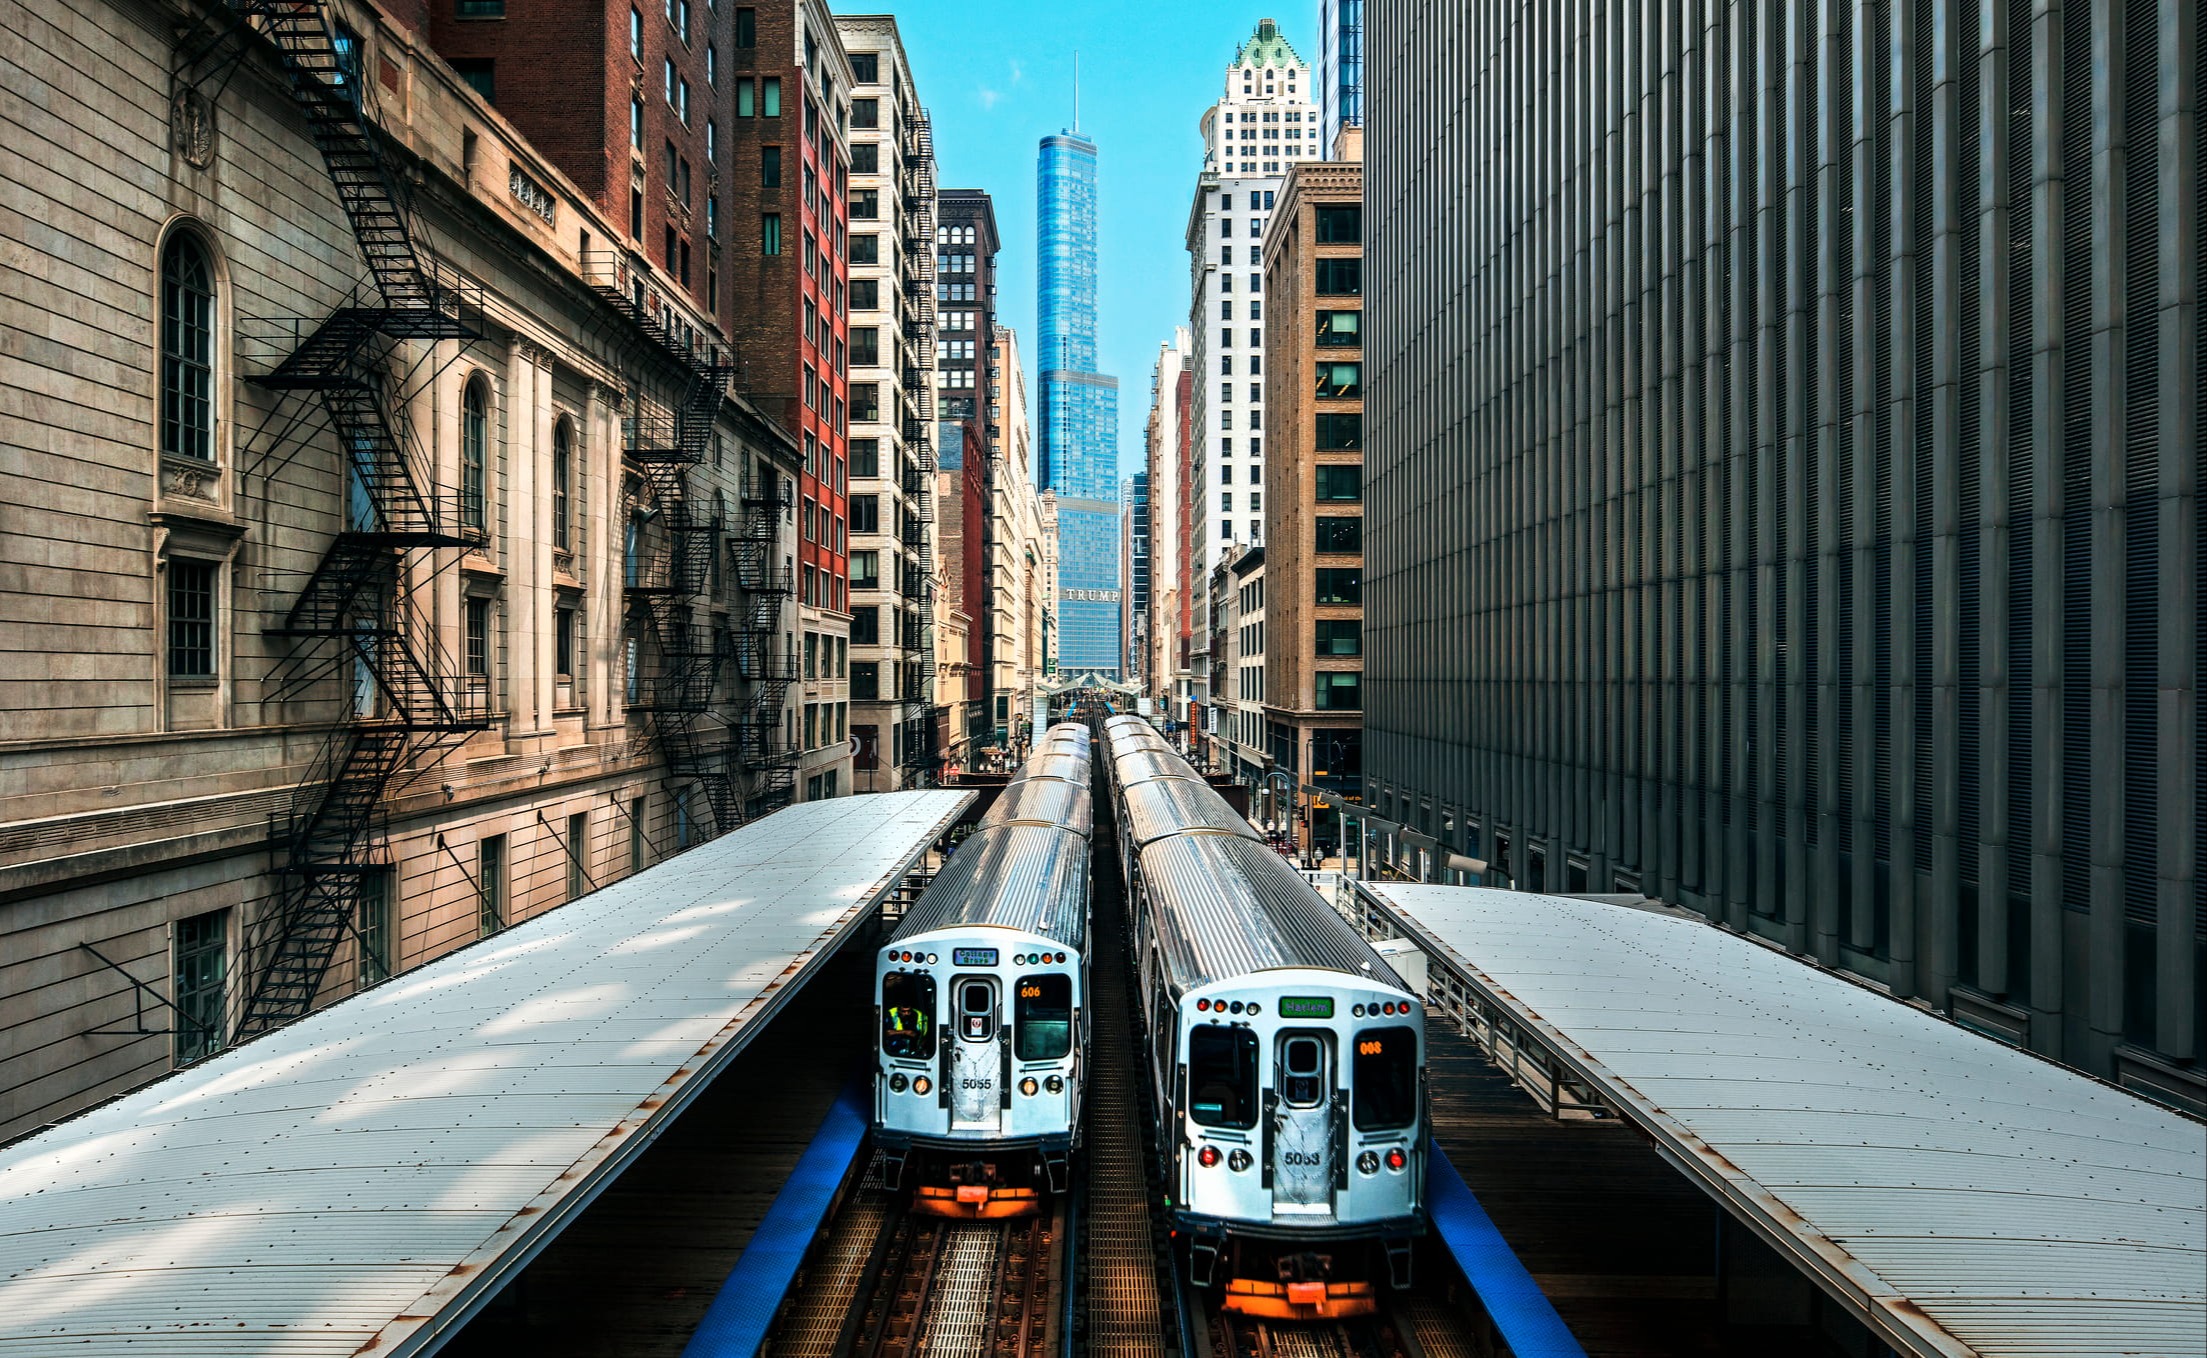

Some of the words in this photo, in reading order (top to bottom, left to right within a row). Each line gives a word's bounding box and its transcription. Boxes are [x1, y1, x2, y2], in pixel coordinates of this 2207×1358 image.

[1066, 588, 1118, 602] TRUMP
[1021, 986, 1041, 998] 606
[1285, 1001, 1328, 1012] Harlem
[962, 1078, 992, 1090] 5055
